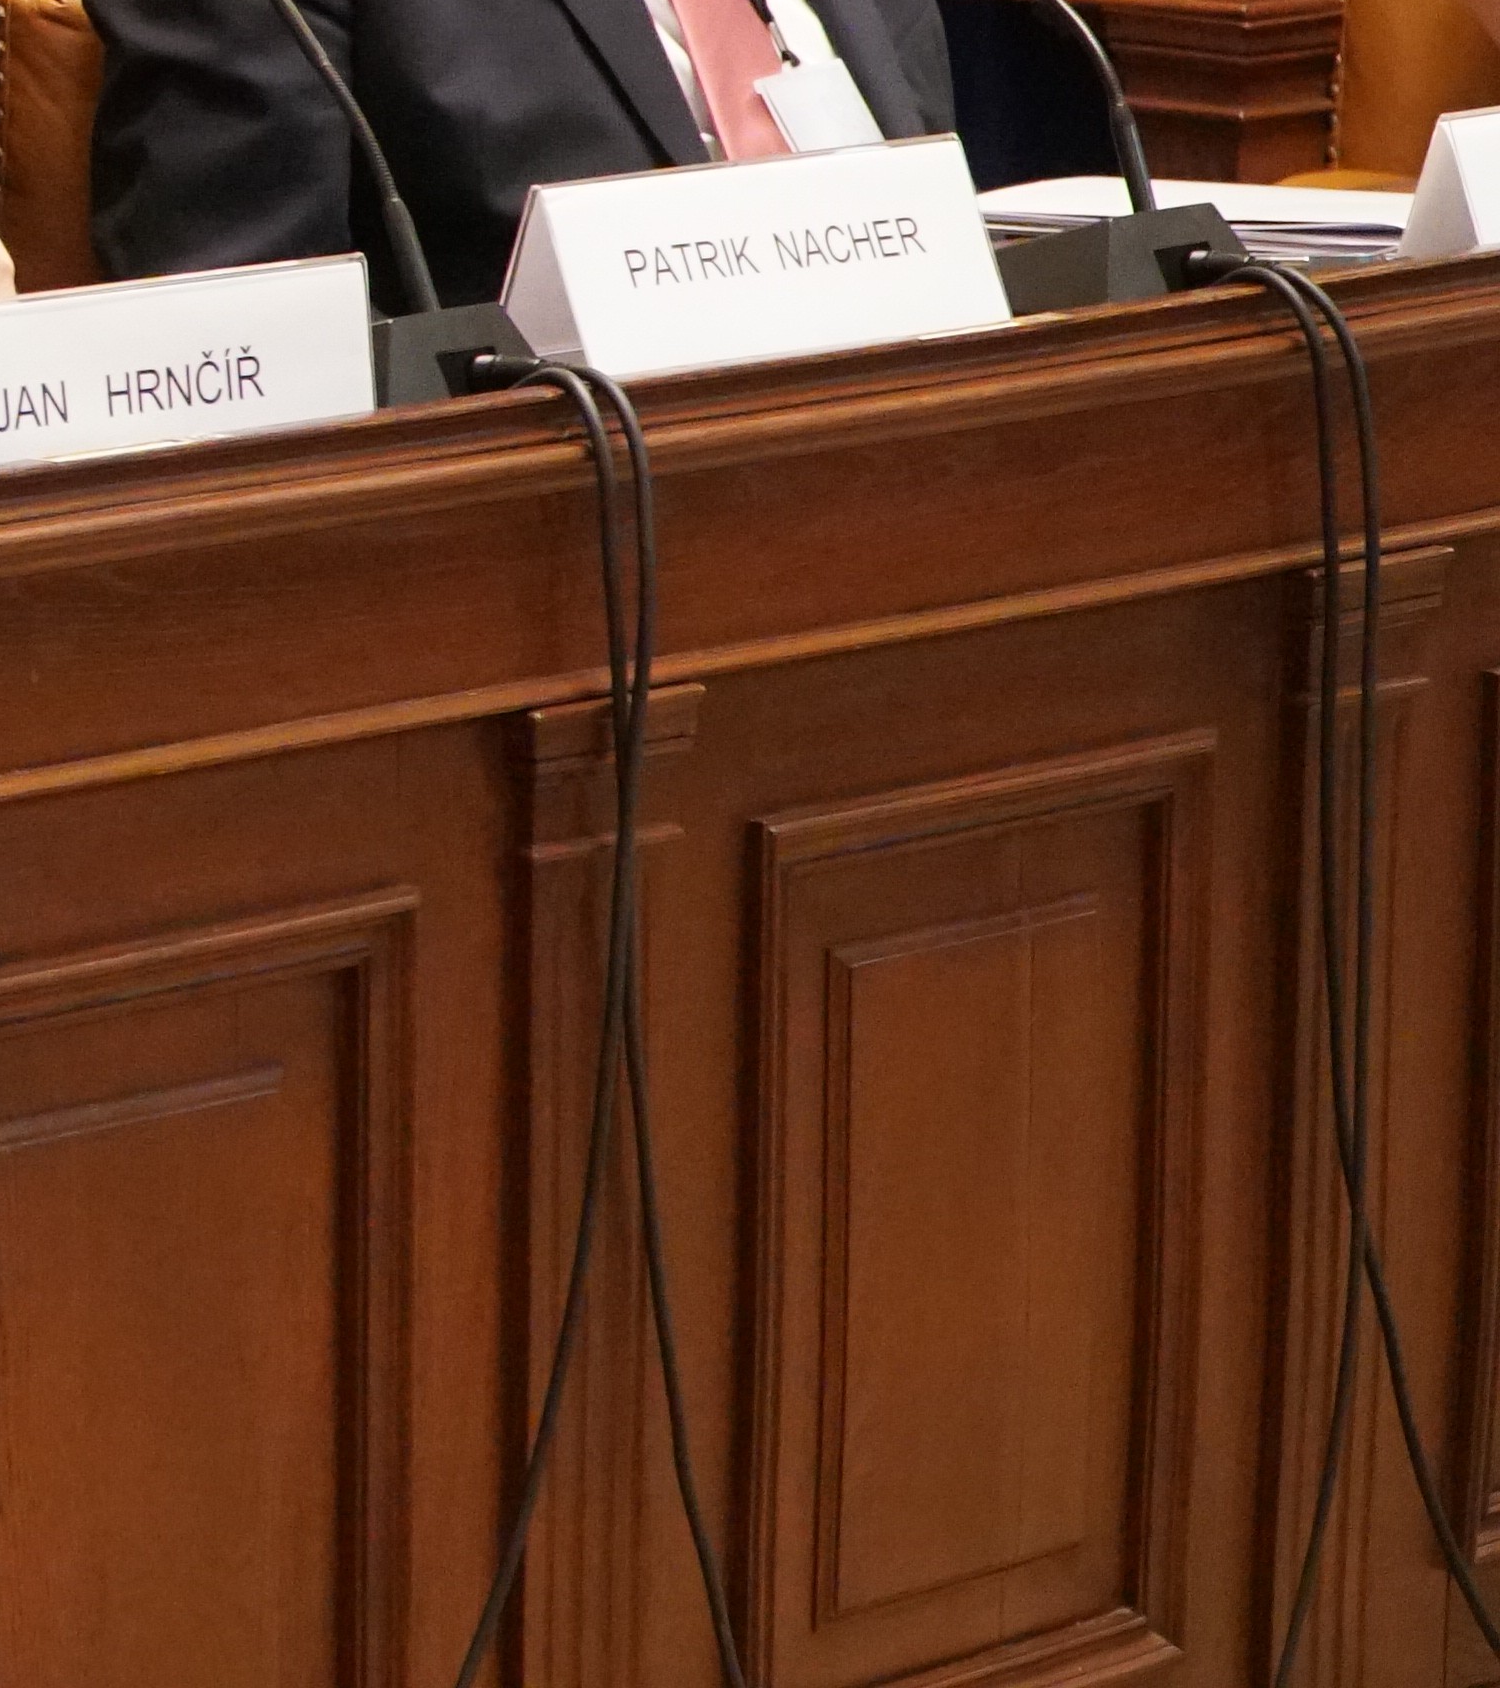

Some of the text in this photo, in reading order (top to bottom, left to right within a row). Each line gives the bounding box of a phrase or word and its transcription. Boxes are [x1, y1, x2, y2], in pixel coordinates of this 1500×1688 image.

[624, 217, 926, 288] PATRIK NACHER
[107, 345, 264, 417] HRNČÍŘ
